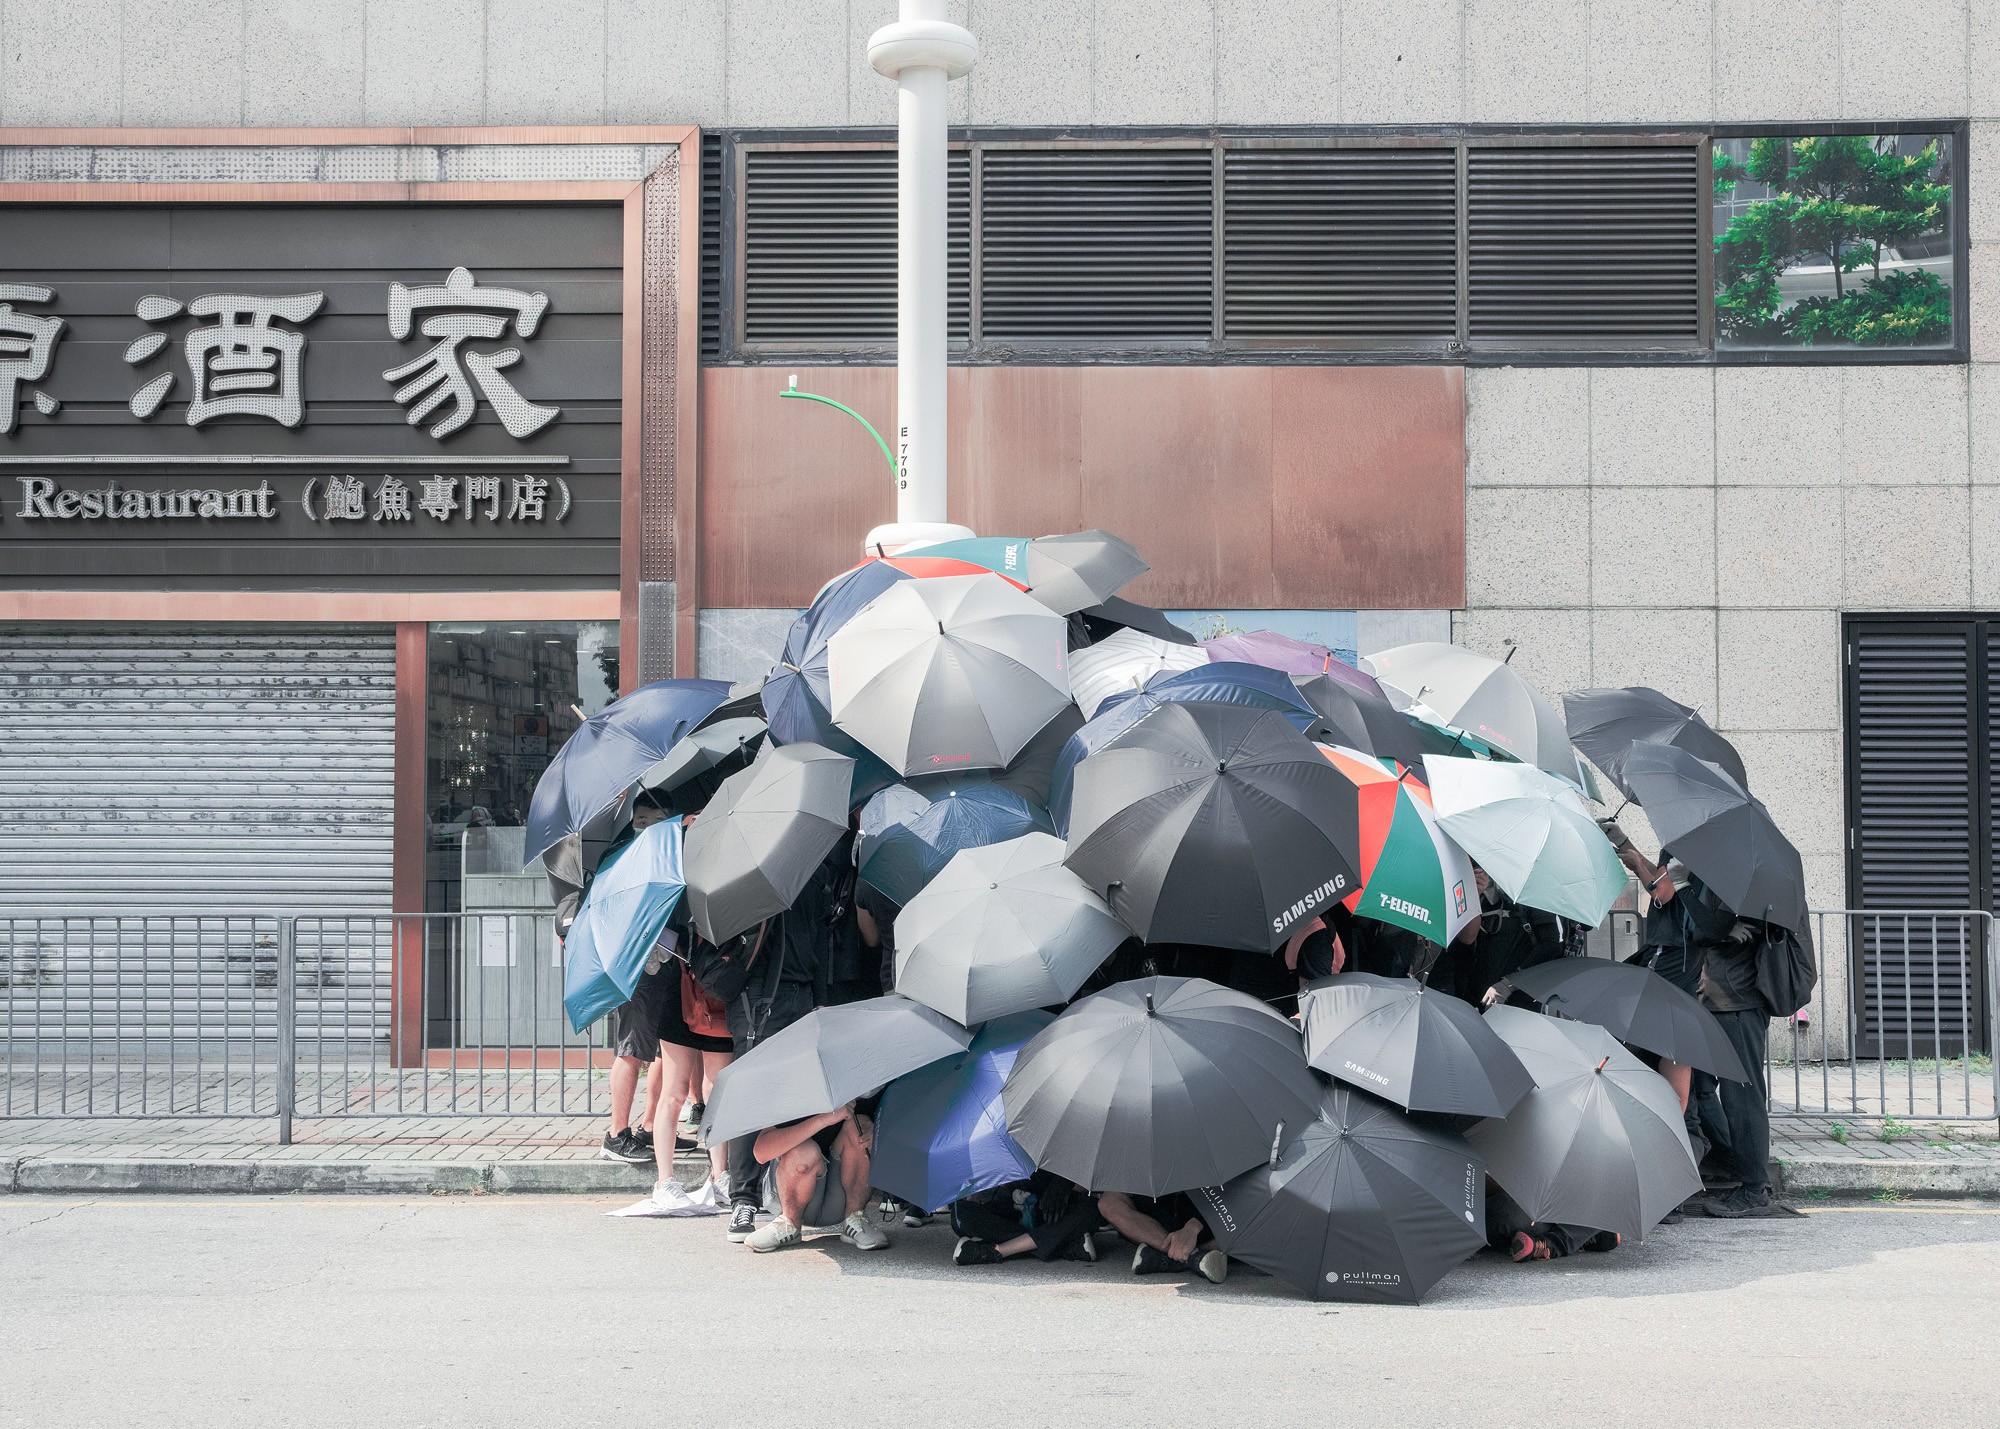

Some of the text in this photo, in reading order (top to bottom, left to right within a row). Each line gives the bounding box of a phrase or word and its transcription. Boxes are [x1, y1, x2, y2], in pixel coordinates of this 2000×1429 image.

[900, 427, 908, 490] E 7709
[16, 477, 277, 519] Restaurant
[1273, 873, 1346, 934] SAMSUNG
[1344, 1060, 1390, 1086] SAMSUNG
[1465, 1163, 1473, 1209] pullman
[1343, 1272, 1400, 1282] pullman
